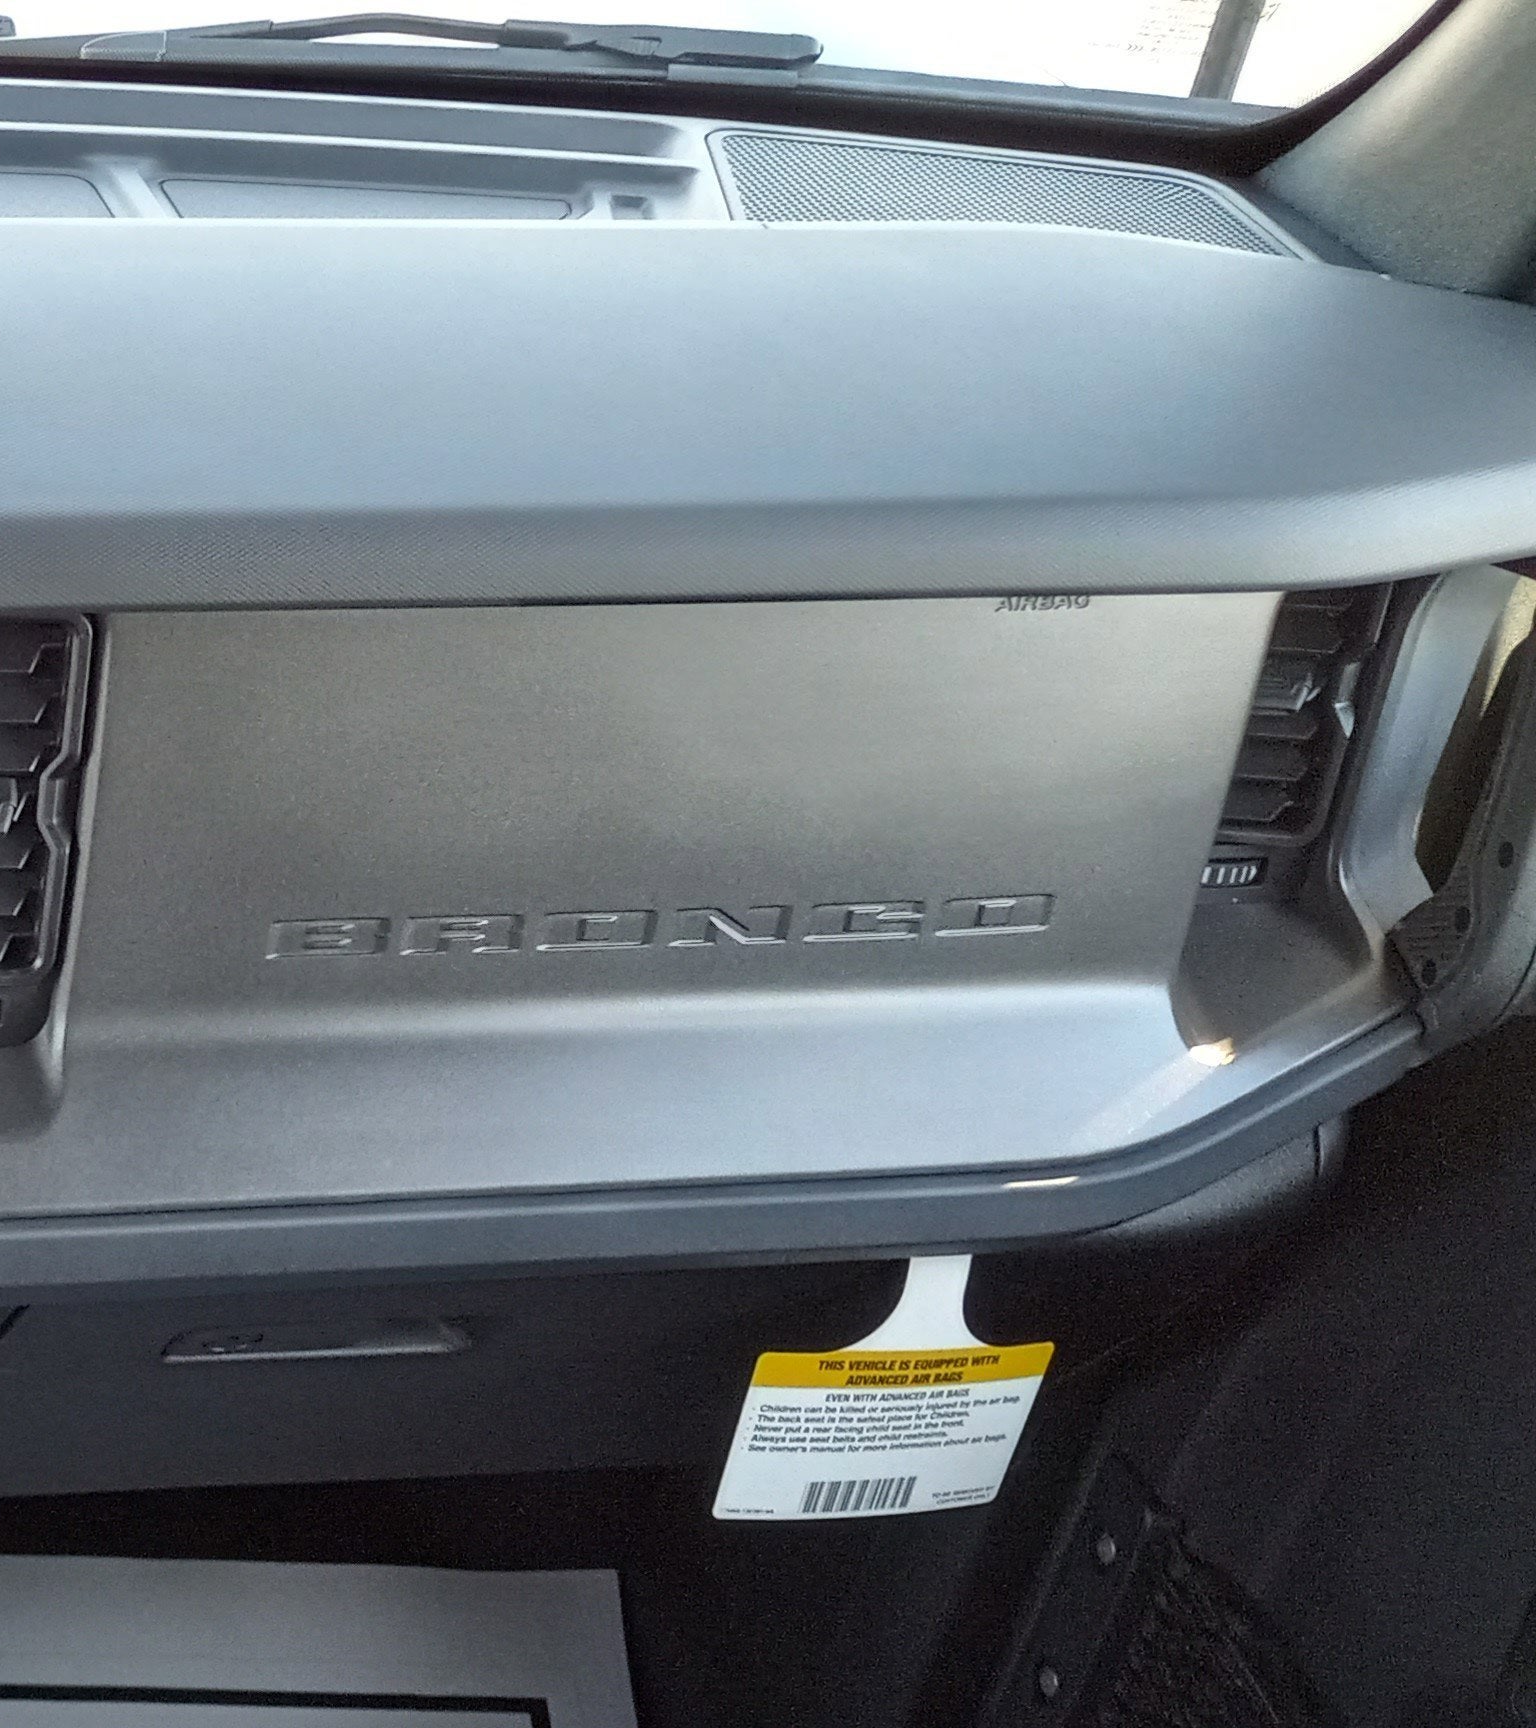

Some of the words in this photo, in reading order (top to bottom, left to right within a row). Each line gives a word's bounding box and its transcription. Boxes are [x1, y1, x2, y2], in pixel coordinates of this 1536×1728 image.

[994, 594, 1091, 613] AIRBAG
[264, 893, 1058, 962] BRONCO
[818, 1360, 845, 1371] THIS
[848, 1360, 897, 1371] VEHICLE
[898, 1360, 912, 1371] IS
[913, 1357, 969, 1371] EQUIPPED
[971, 1354, 1001, 1367] WITH
[845, 1374, 909, 1386] ADVANCED
[910, 1373, 931, 1385] AIR
[933, 1372, 964, 1384] BAGS
[825, 1393, 851, 1403] EVEN
[852, 1393, 878, 1403] WITH
[878, 1391, 927, 1402] ADVANCED
[928, 1390, 944, 1400] AIR
[946, 1388, 970, 1398] BAGS
[760, 1404, 802, 1414] Children
[757, 1414, 776, 1423] The
[777, 1414, 802, 1423] back
[753, 1424, 783, 1433] Never
